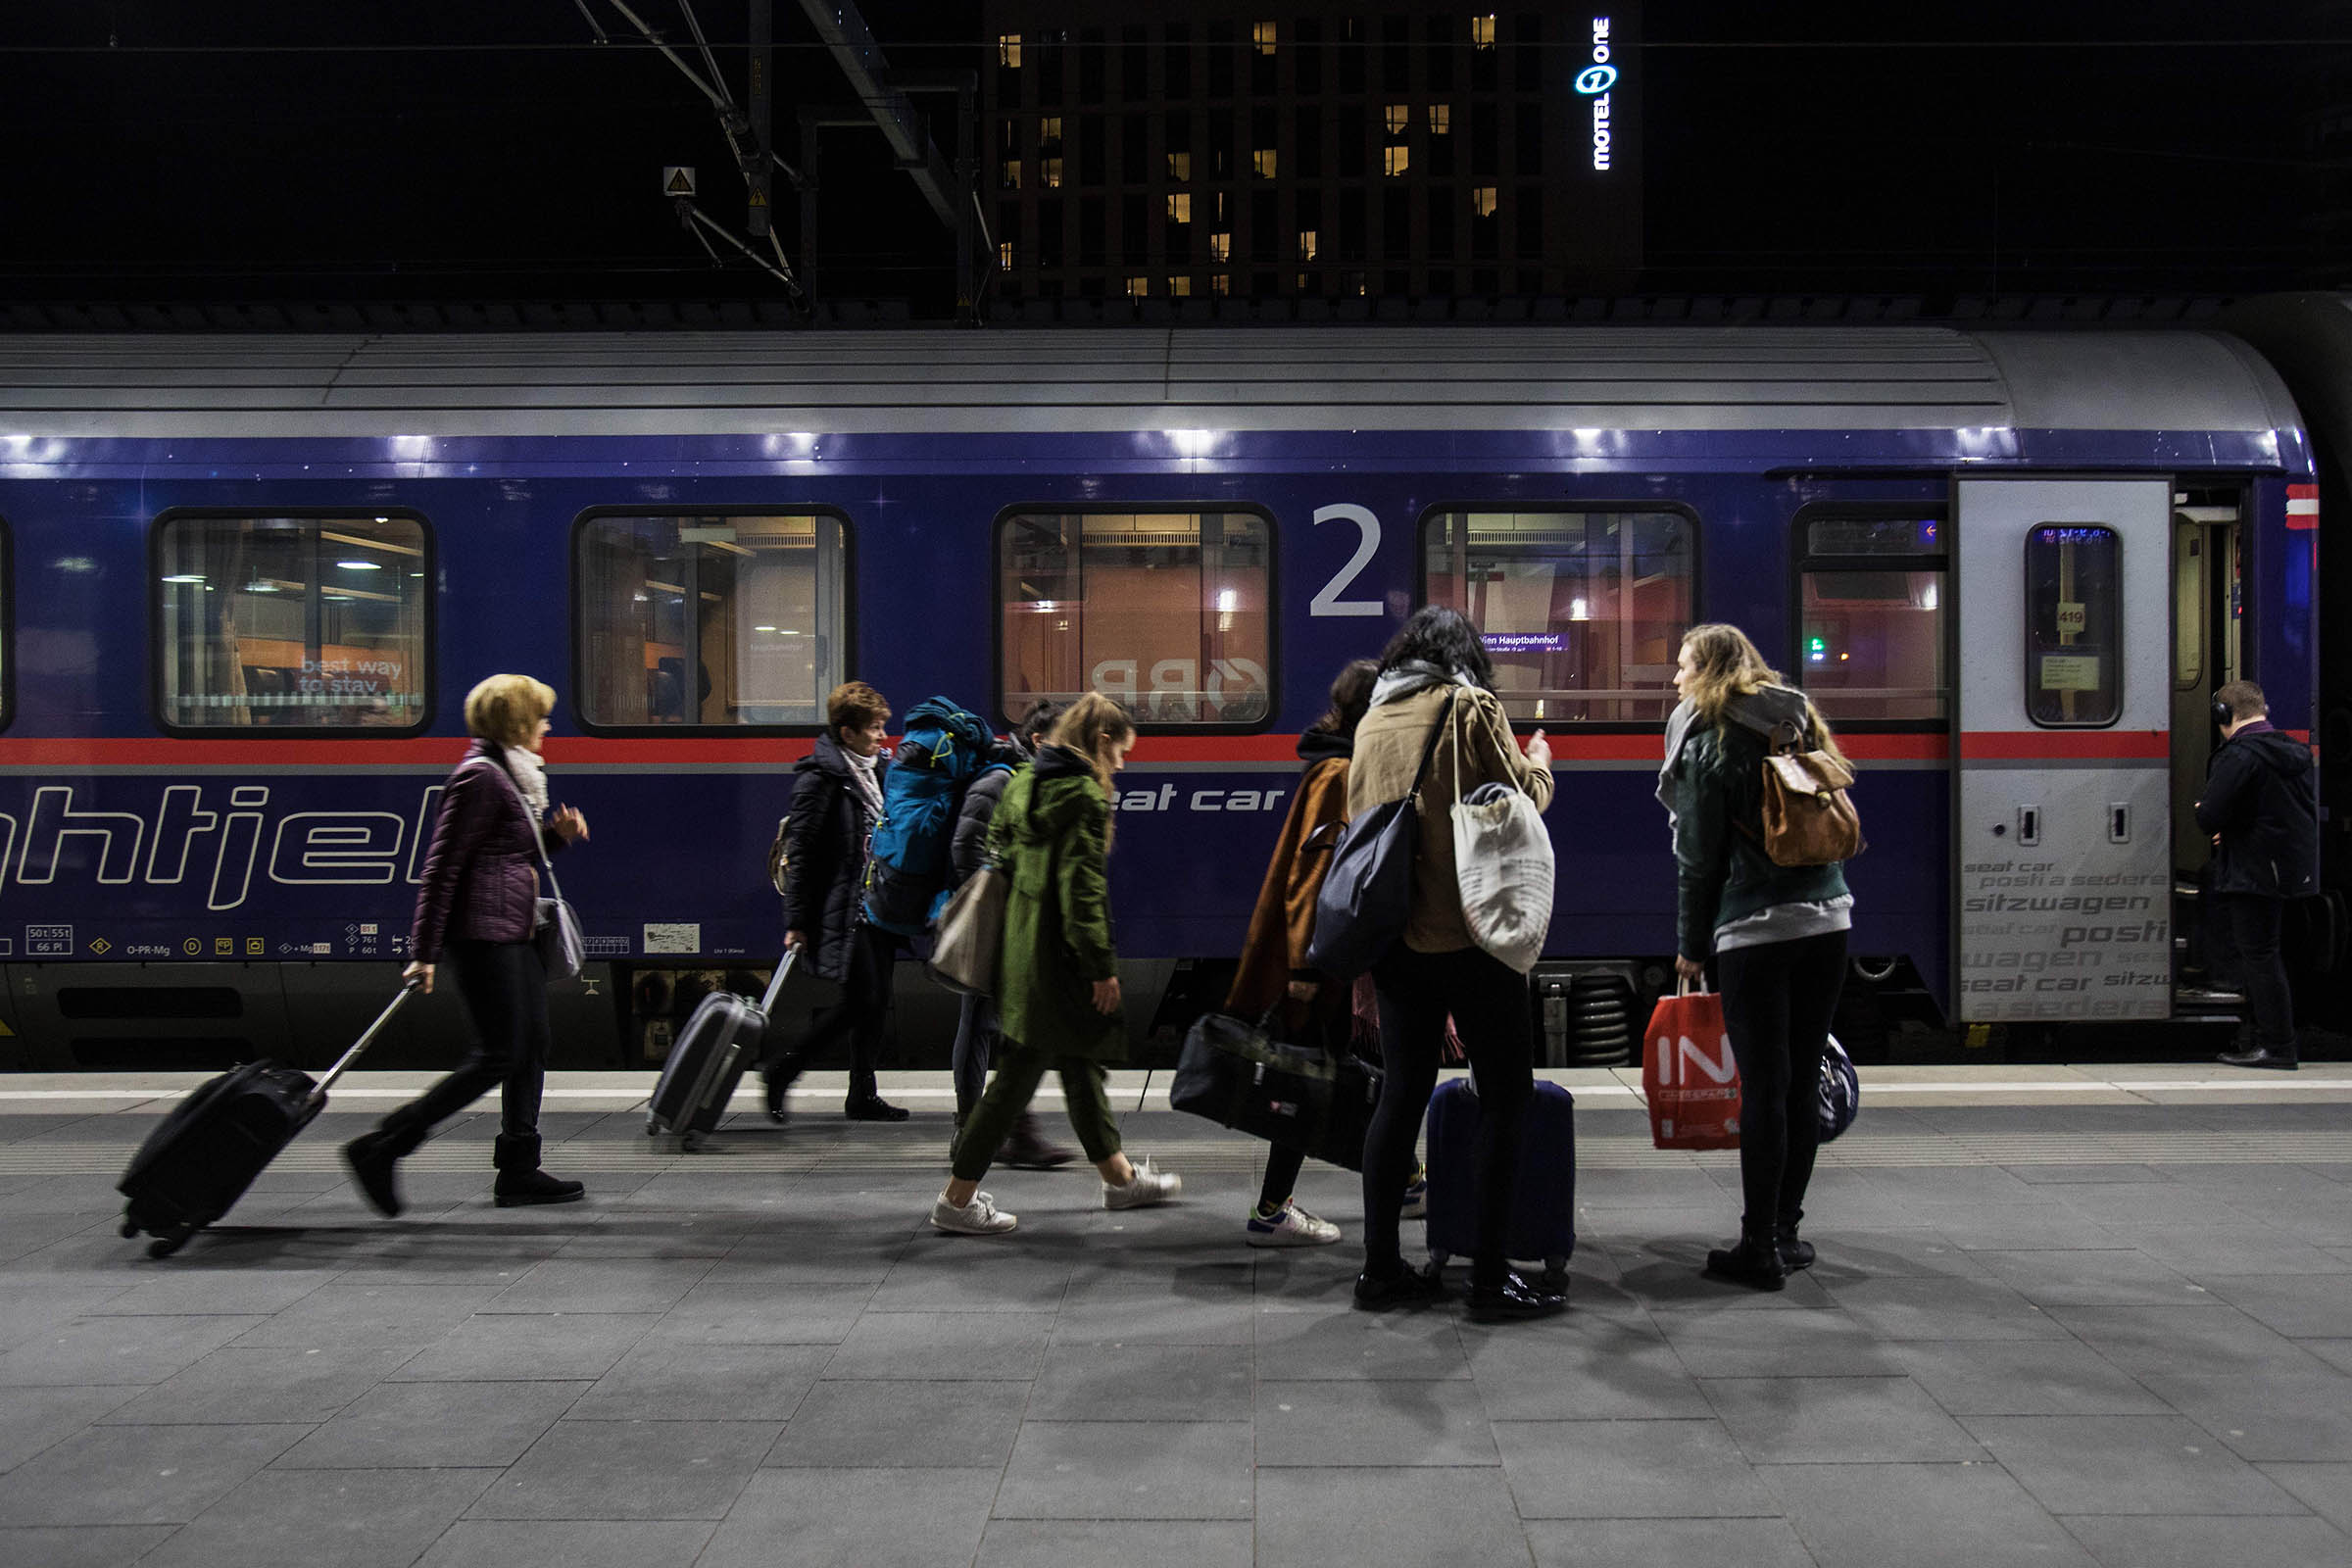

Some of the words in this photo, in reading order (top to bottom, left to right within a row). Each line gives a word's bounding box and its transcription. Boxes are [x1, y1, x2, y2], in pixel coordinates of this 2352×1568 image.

[1309, 503, 1384, 616] 2
[2059, 611, 2083, 623] 419
[1498, 635, 1559, 646] Hauptbahnhof
[300, 654, 350, 674] best
[356, 660, 402, 680] way
[299, 675, 322, 692] to
[1110, 784, 1177, 811] at
[1190, 790, 1285, 811] car
[1963, 860, 2014, 872] seat
[2018, 861, 2055, 872] car
[1979, 873, 2045, 890] posti
[2070, 873, 2168, 887] sedere
[1963, 894, 2152, 915] sitzwagen
[2060, 920, 2168, 949] posti
[36, 943, 50, 952] 66
[1961, 951, 2104, 973] wagen
[2035, 978, 2092, 992] car
